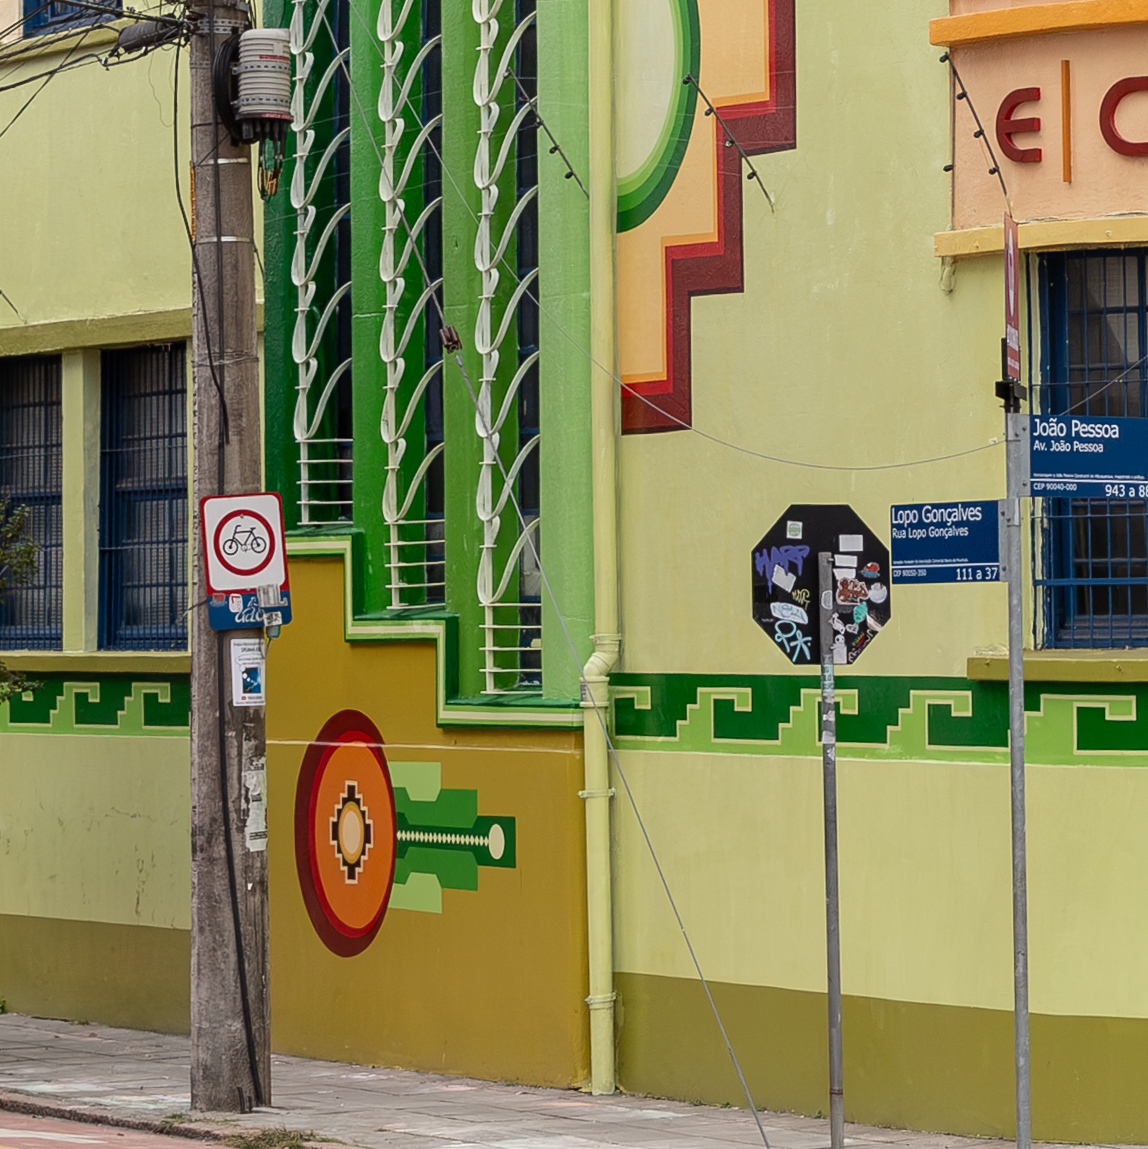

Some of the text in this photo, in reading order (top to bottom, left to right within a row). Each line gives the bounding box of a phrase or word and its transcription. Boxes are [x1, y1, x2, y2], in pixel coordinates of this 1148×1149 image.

[1032, 417, 1119, 439] João Pessoa
[1033, 439, 1104, 453] Av. João Pessoa
[1033, 482, 1045, 490] CEP
[1105, 484, 1126, 497] 943
[1128, 487, 1136, 497] a
[891, 503, 982, 528] Lopo Gonçalves
[892, 525, 969, 540] Rua Lopo Gonçalves
[956, 567, 998, 581] 111 a 37
